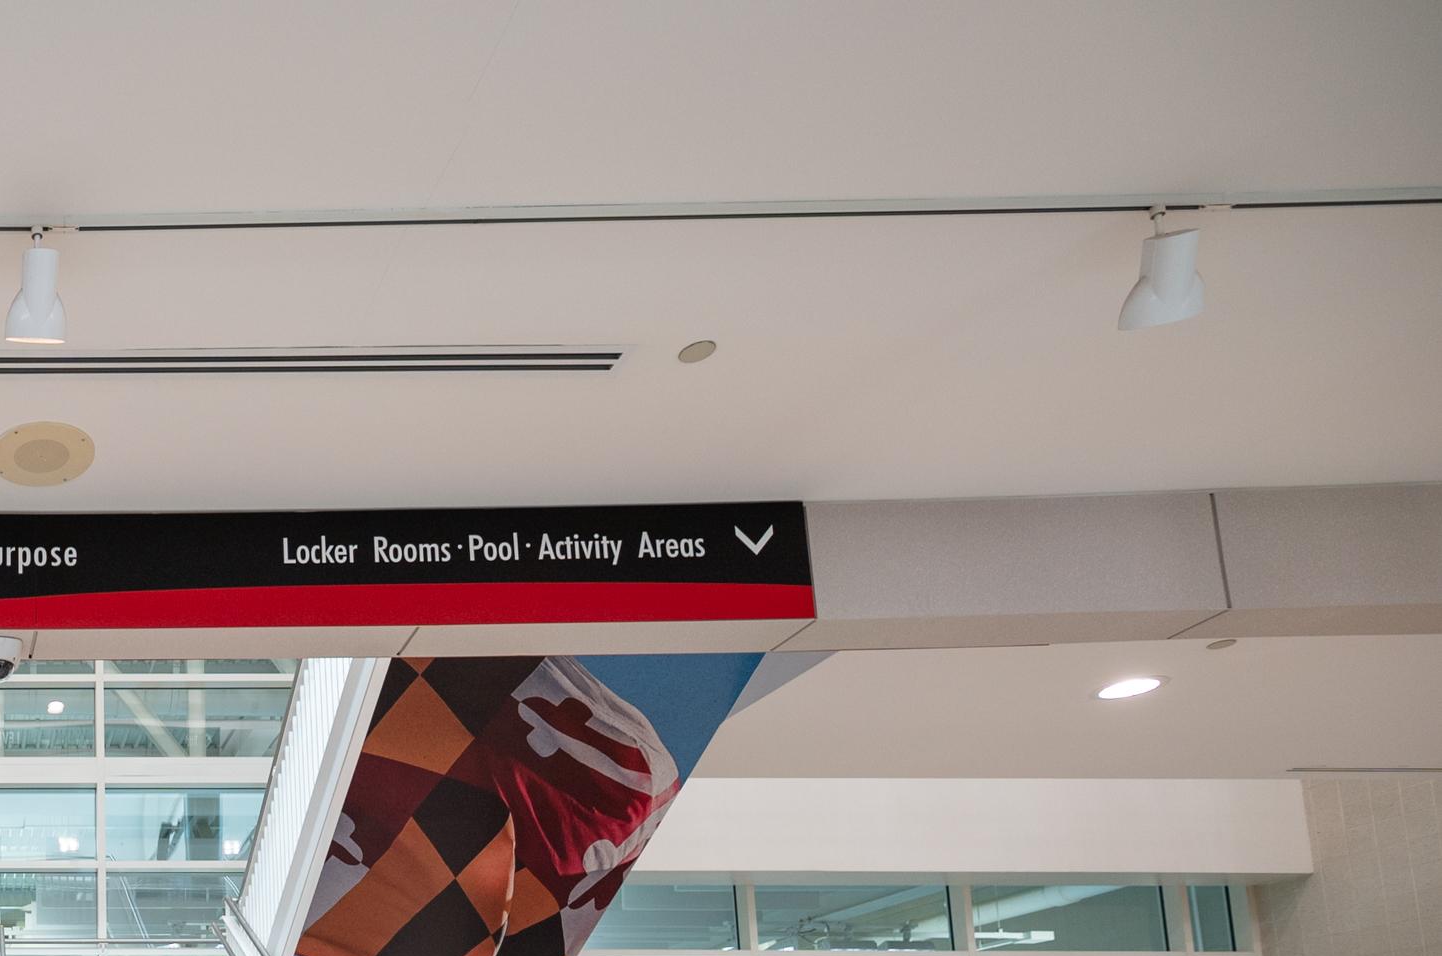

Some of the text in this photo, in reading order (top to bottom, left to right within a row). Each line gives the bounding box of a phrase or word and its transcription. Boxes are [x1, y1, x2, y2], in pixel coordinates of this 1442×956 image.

[282, 531, 706, 566] Locker Rooms Pool Activity Areas
